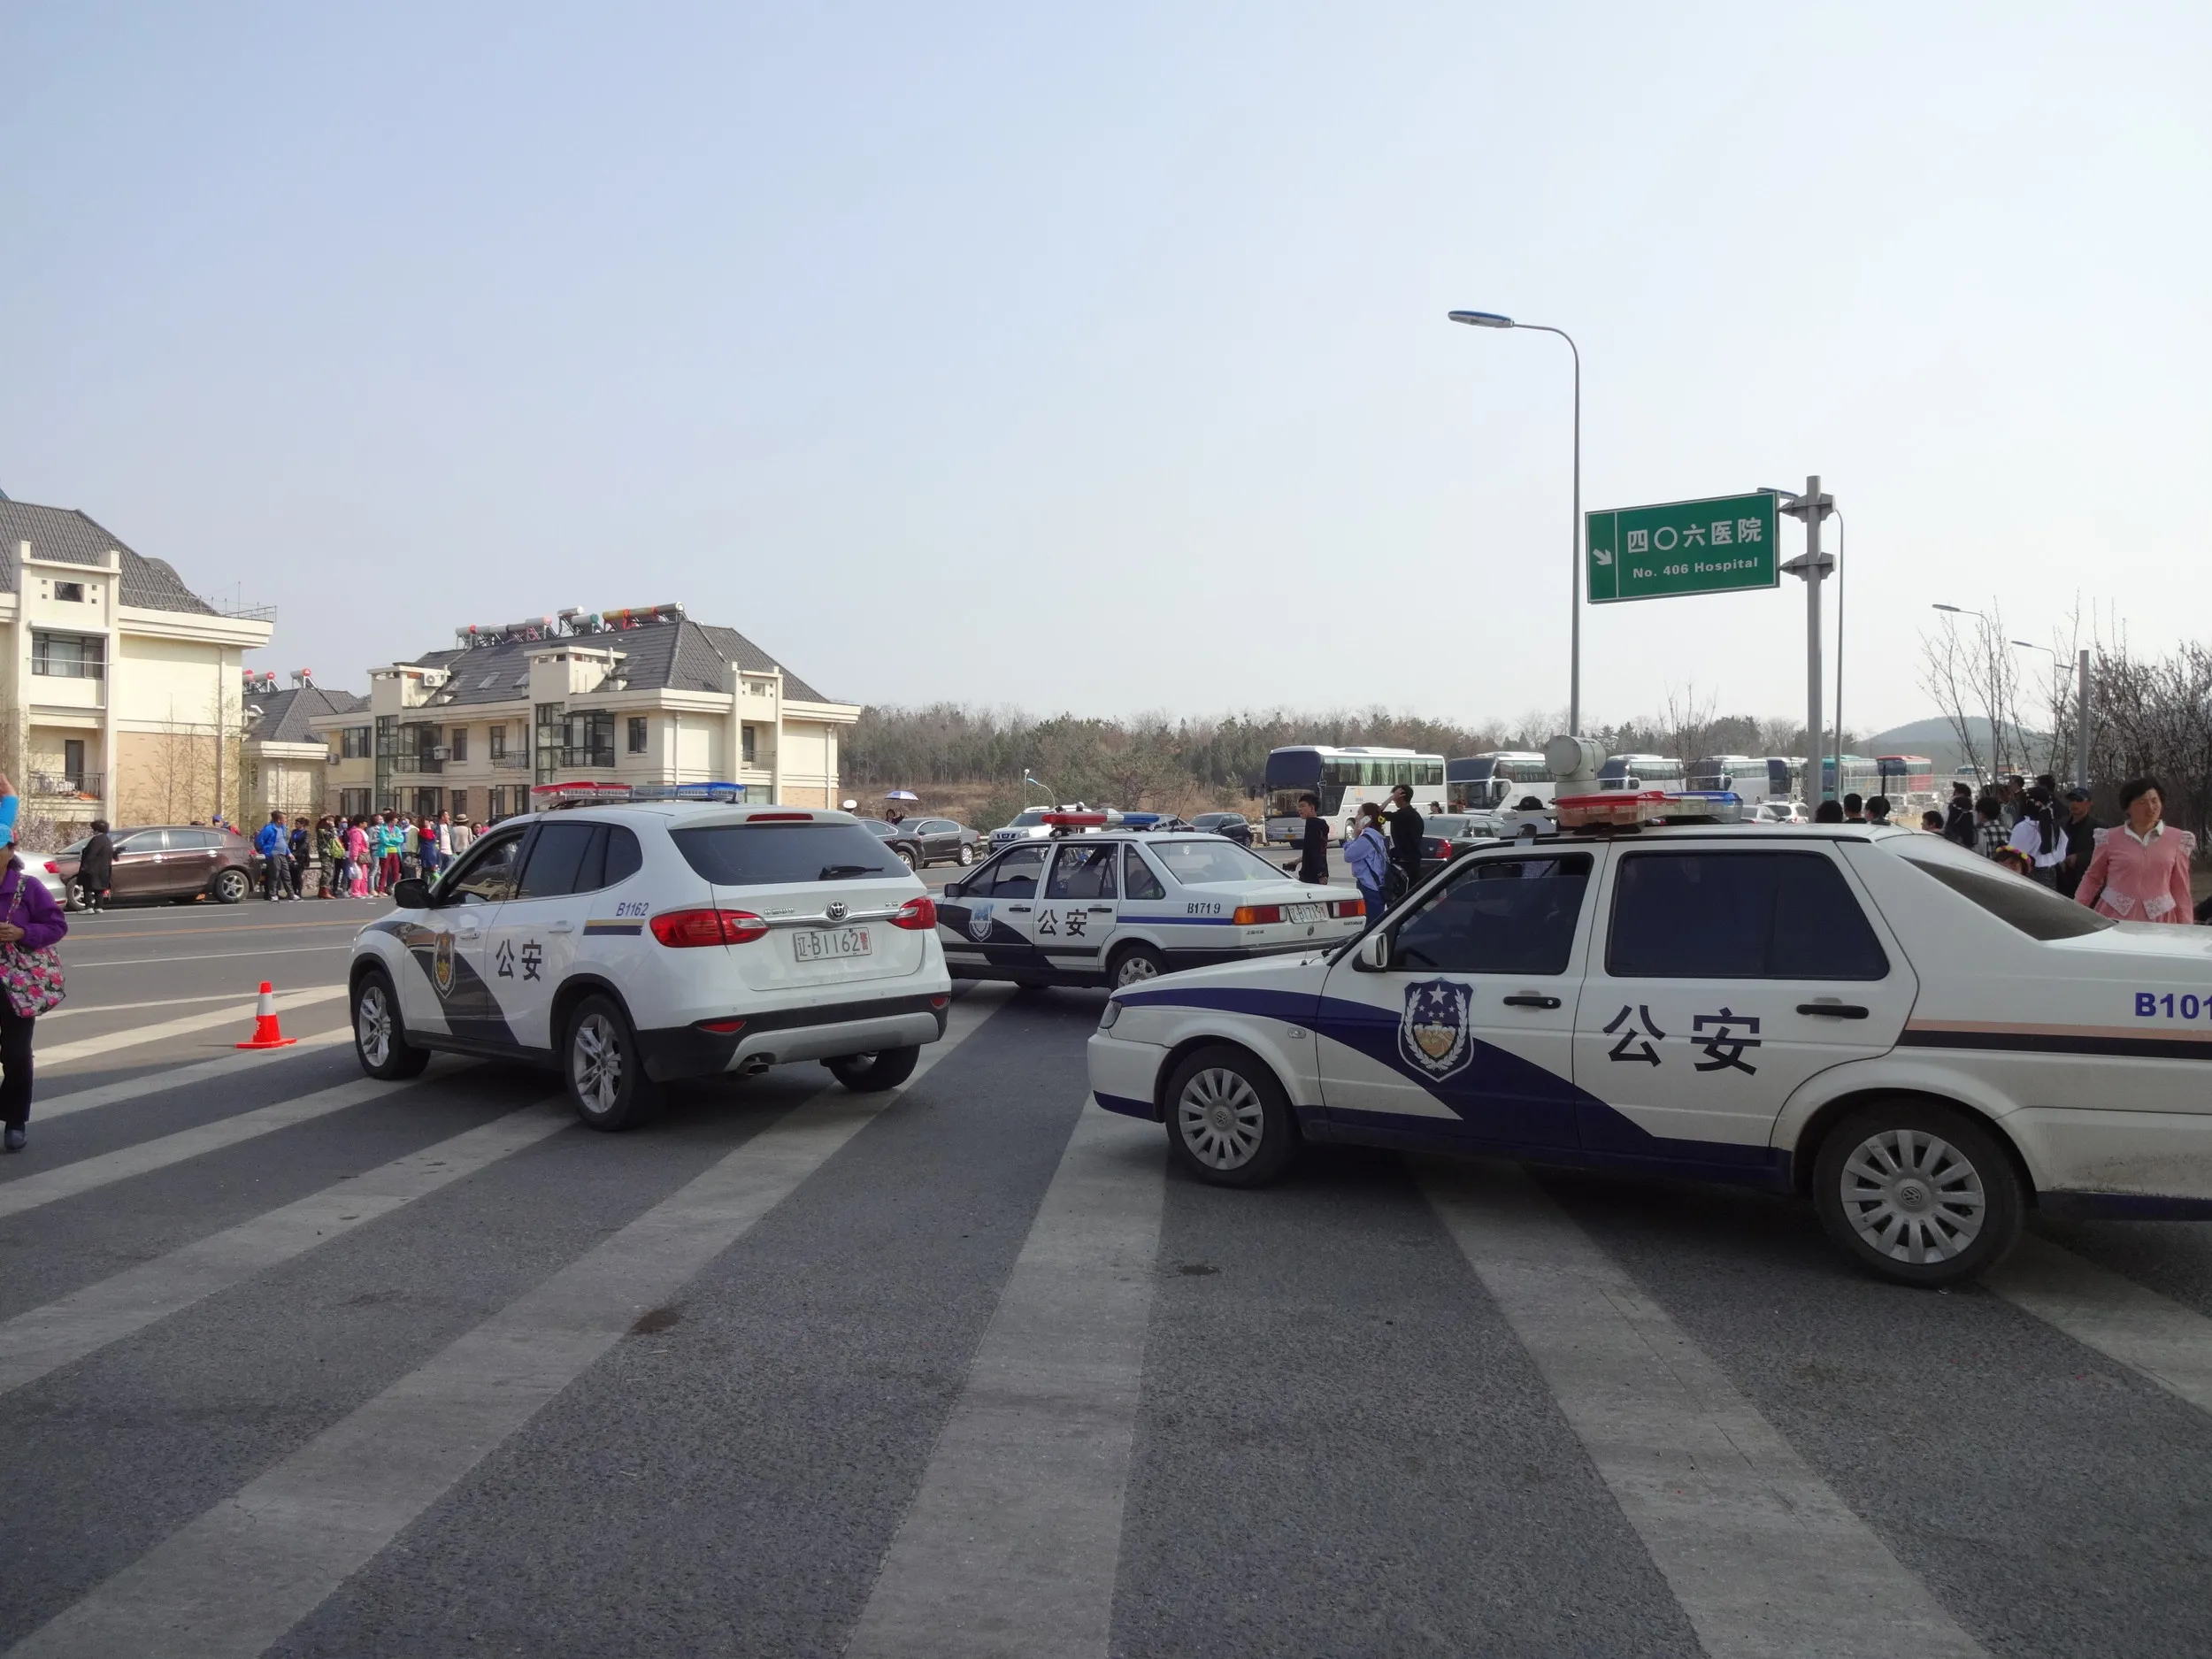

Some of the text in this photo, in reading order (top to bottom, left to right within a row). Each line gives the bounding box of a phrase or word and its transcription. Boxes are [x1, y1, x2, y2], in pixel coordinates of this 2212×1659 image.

[1627, 517, 1763, 554] 四〇六医院
[1633, 557, 1758, 579] No. 406 Hospital
[616, 902, 649, 917] B1162
[1187, 902, 1221, 915] B1719
[1037, 909, 1087, 937] 公安
[495, 939, 542, 982] 公安
[1602, 1004, 1762, 1076] 公安
